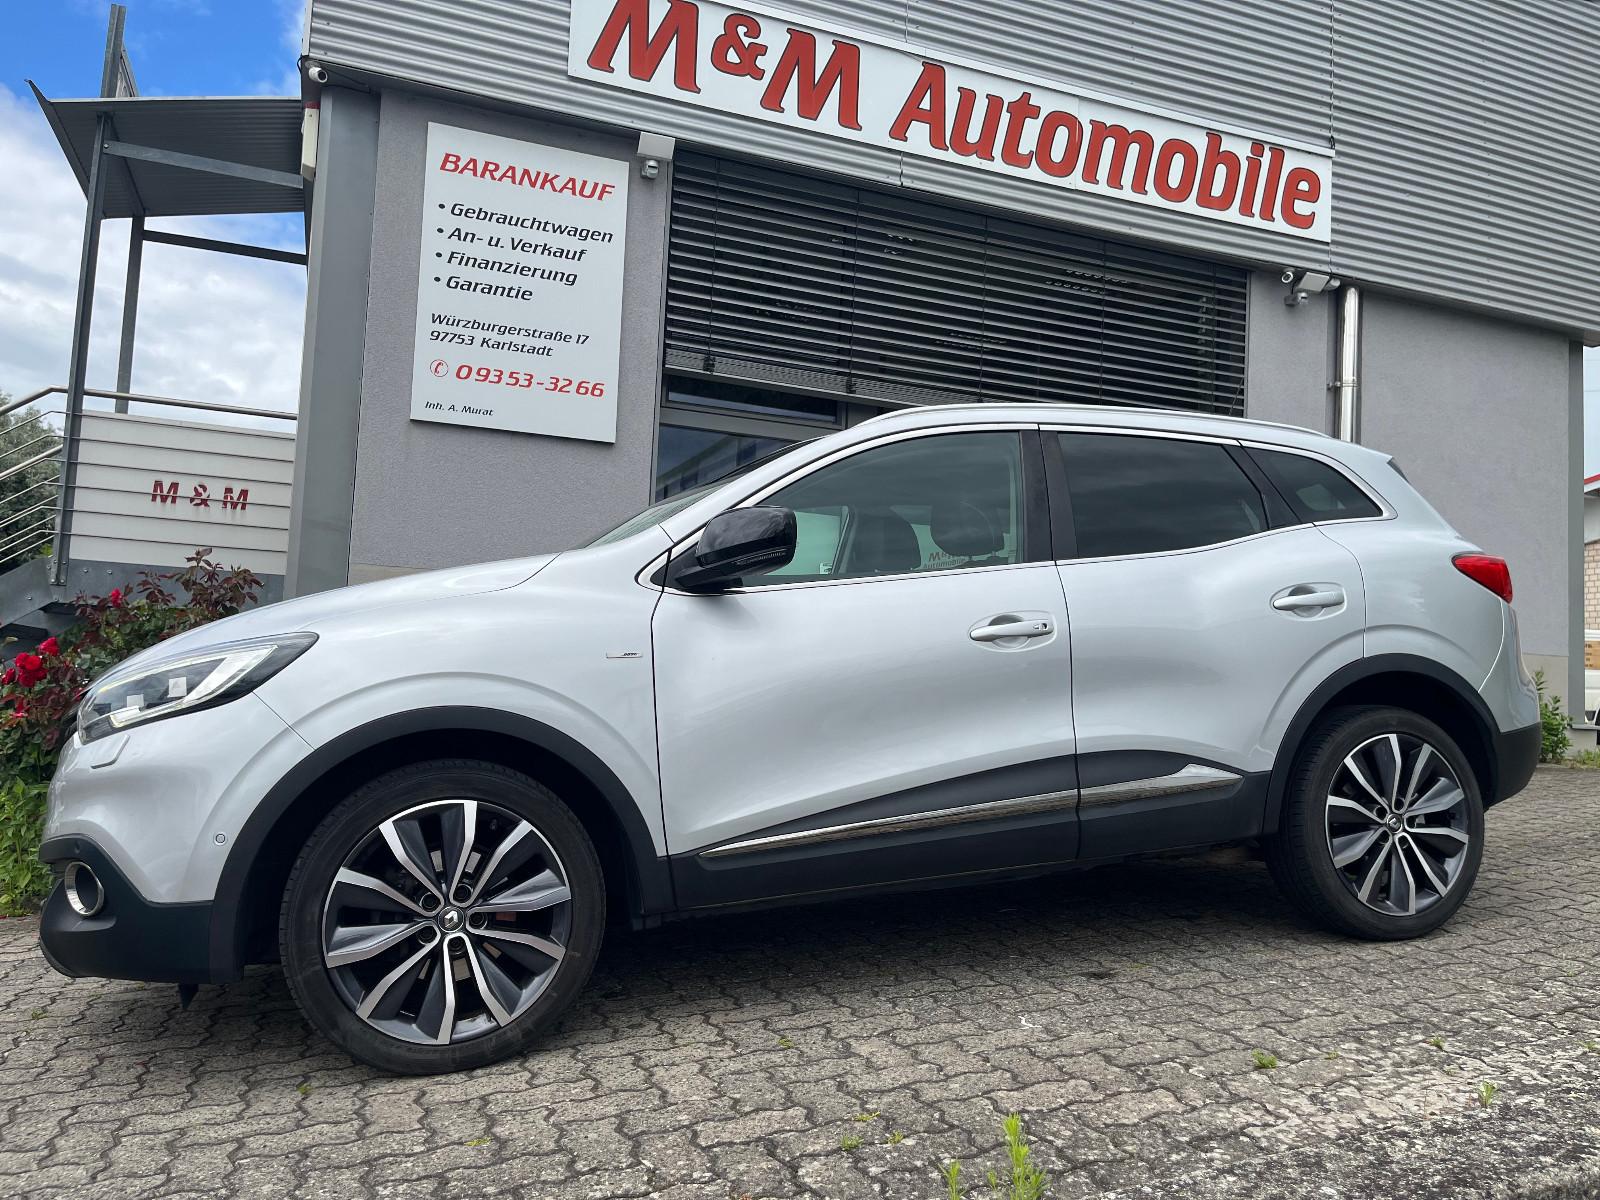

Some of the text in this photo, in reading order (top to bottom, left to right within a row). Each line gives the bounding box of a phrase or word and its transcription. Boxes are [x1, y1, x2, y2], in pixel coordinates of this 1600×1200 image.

[587, 0, 1321, 230] M&M Automobile
[440, 153, 615, 201] BARANKAUF
[450, 203, 613, 244] Gebrauchtwagen
[448, 227, 588, 262] An- u. Verkauf
[447, 251, 578, 287] Finanzierung
[446, 275, 533, 301] Garantie
[429, 330, 554, 357] 97753 Karlstadt
[431, 312, 590, 345] Würzburgerstraße 17
[424, 401, 494, 416] Inh. A. Murat
[151, 480, 179, 504] M
[222, 487, 249, 510] M
